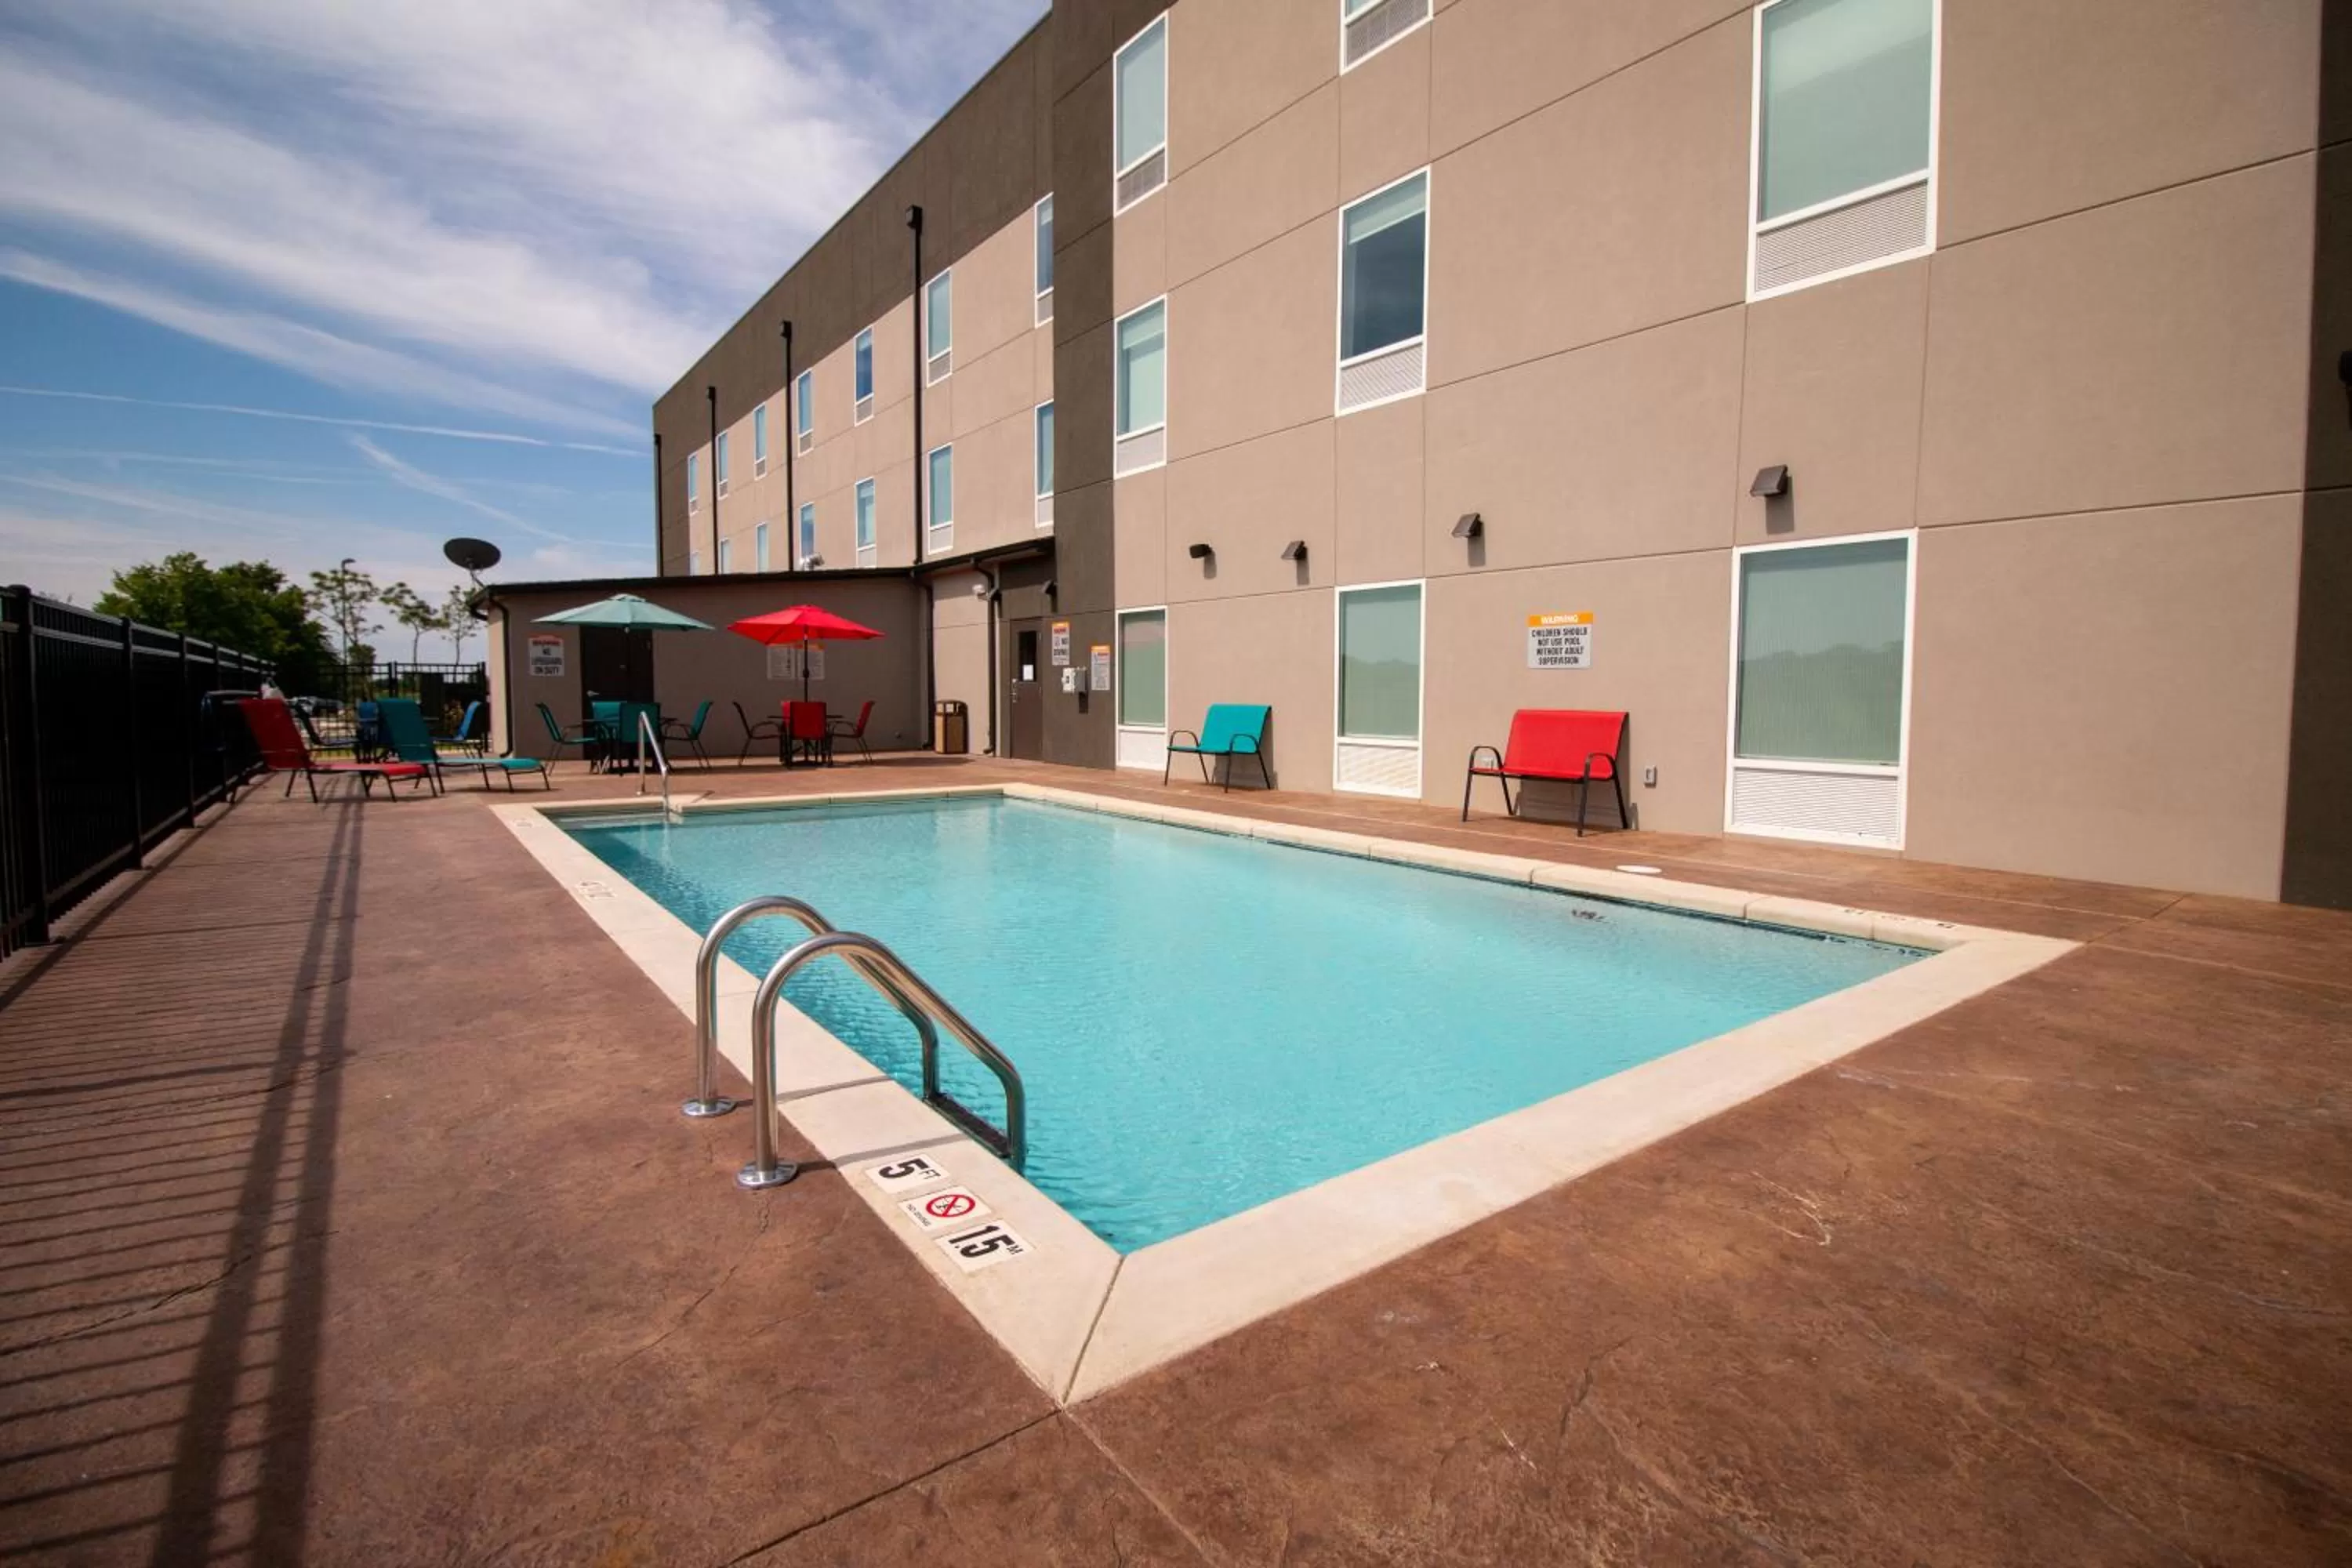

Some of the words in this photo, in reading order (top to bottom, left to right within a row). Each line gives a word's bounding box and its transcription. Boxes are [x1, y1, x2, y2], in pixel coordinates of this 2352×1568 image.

[1540, 615, 1579, 625] WARNING
[1531, 628, 1561, 637] CHILDREN
[1563, 627, 1588, 636] SHOULD
[1564, 637, 1581, 645] POOL
[1565, 646, 1584, 655] ADULT
[1537, 656, 1579, 665] SUPERVISION
[878, 1158, 929, 1179] 5
[919, 1169, 942, 1179] FT
[1007, 1244, 1024, 1255] M
